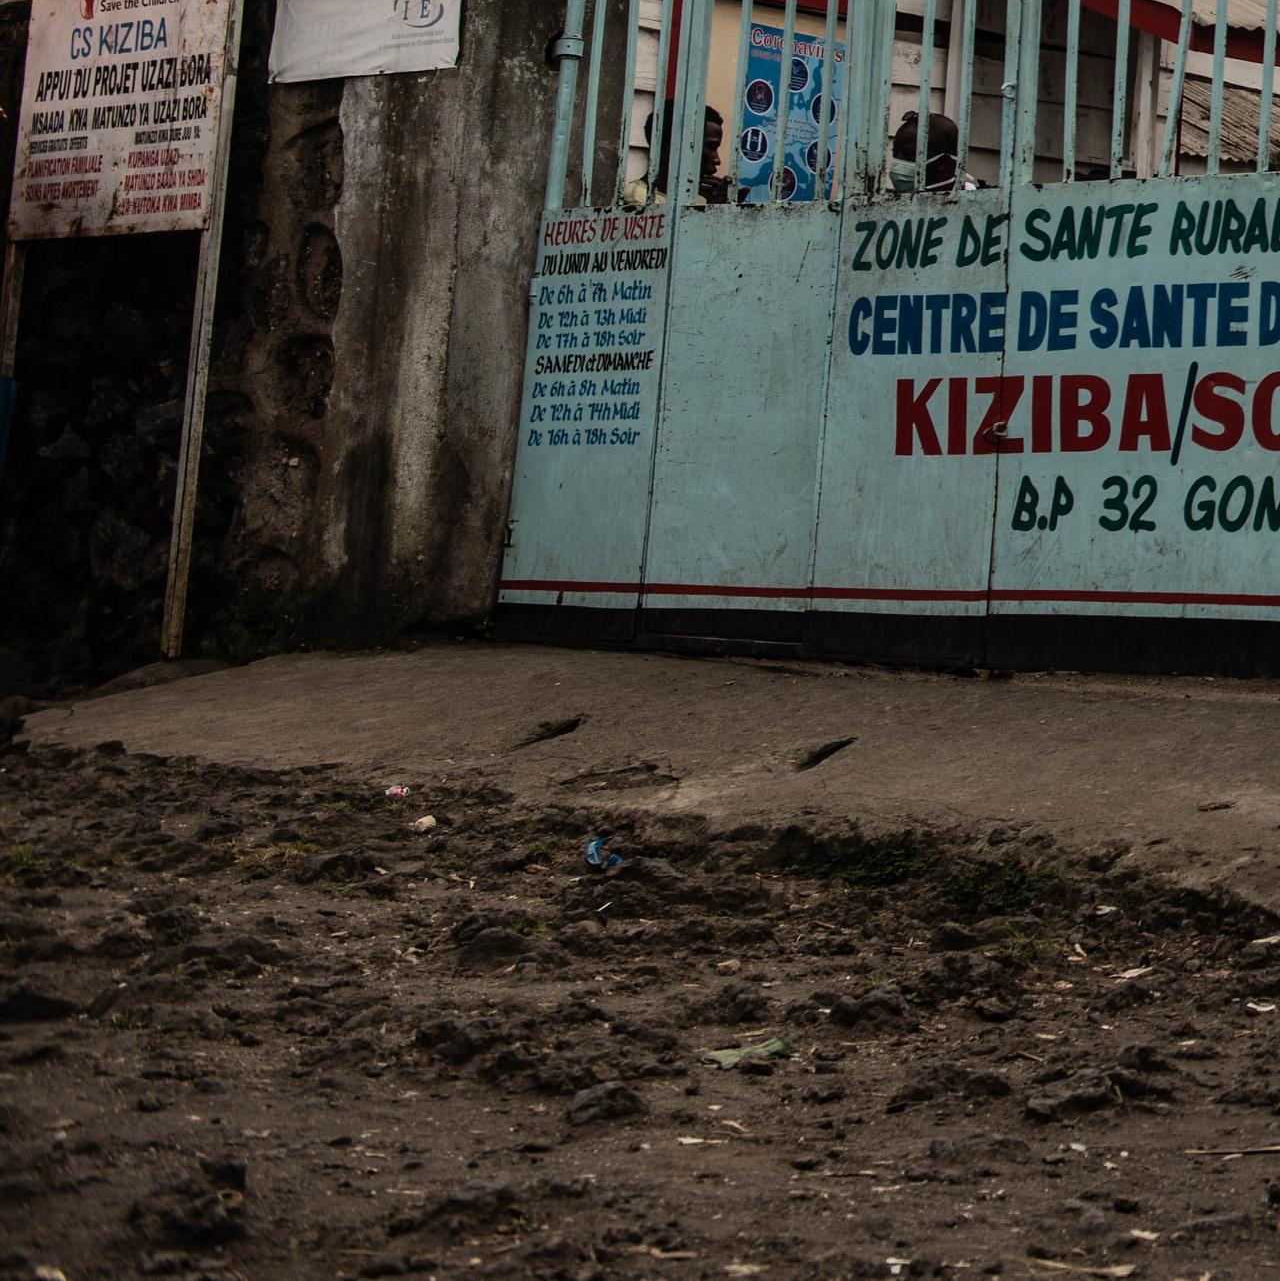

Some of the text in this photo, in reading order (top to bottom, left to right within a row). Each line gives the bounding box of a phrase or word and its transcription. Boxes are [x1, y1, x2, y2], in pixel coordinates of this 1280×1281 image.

[101, 0, 122, 12] Save
[70, 17, 167, 59] CS KIZIBA
[35, 53, 211, 102] APPUI DU PROJET UZAZI BORA
[32, 96, 208, 135] MSAADA KWA MATUNZO YA UZAZI BORA
[128, 148, 180, 168] KUPANGA UZAZI
[124, 174, 156, 192] MATUNZO
[545, 214, 666, 246] HEURES DE VISITE
[851, 215, 946, 271] ZONE
[956, 213, 1009, 267] DE
[1019, 202, 1158, 261] SANTE
[542, 248, 667, 276] DU LUNDI AU VENDREDI
[539, 286, 553, 306] De
[558, 286, 573, 303] 6h
[578, 283, 587, 302] à
[612, 282, 651, 301] Matin
[538, 311, 553, 328] De
[559, 310, 577, 326] 12h
[580, 309, 589, 326] à
[619, 308, 646, 324] Midi
[849, 291, 1006, 355] CENTRE
[1018, 290, 1079, 351] DE
[1089, 281, 1253, 349] SANTE
[536, 333, 551, 349] De
[556, 333, 577, 347] 17h
[581, 332, 590, 347] à
[619, 330, 645, 345] Soir
[535, 354, 586, 374] SAMEDI
[597, 350, 654, 373] DIMANCHE
[532, 380, 546, 398] De
[551, 380, 564, 396] 6h
[567, 378, 575, 395] à
[602, 378, 640, 395] Matin
[530, 404, 545, 422] De
[551, 405, 571, 421] 12h
[574, 403, 582, 420] à
[612, 402, 640, 420] Midi
[528, 430, 542, 446] De
[548, 429, 568, 445] 16h
[573, 428, 581, 445] à
[611, 428, 640, 445] Soir
[1011, 476, 1074, 532] B.P
[1099, 476, 1158, 532] 32
